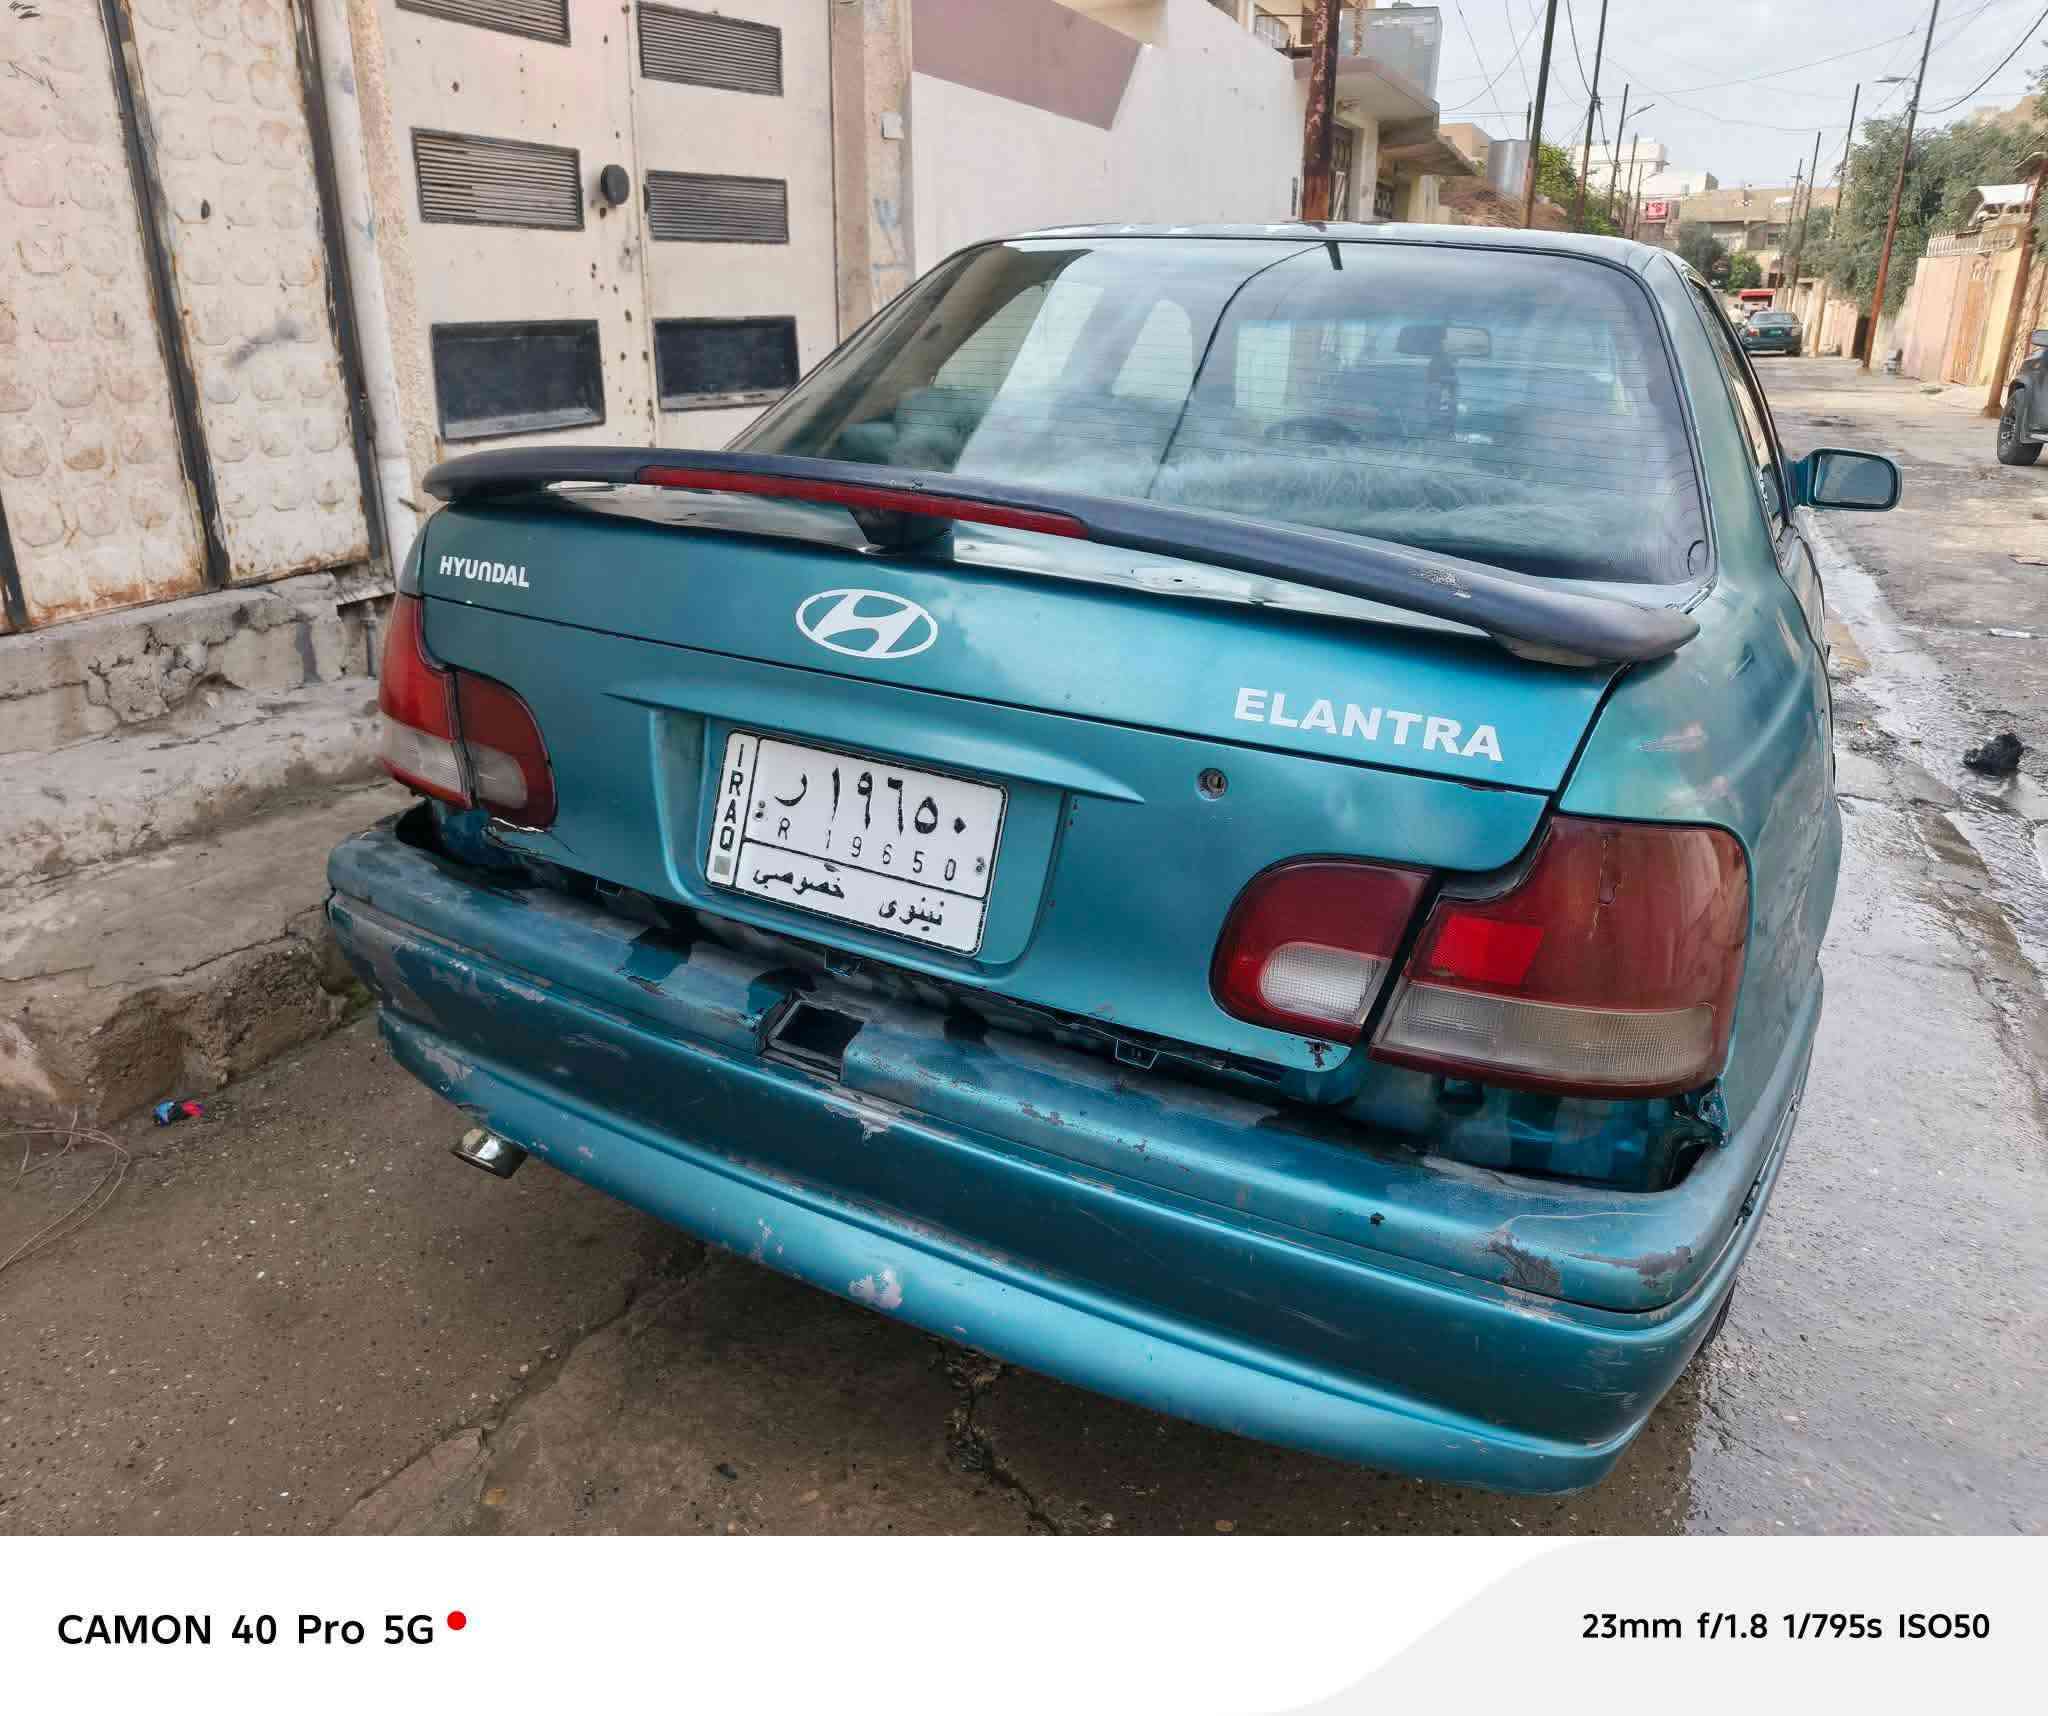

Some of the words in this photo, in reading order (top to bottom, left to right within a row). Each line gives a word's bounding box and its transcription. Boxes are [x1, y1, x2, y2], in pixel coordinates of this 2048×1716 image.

[1234, 687, 1504, 762] ELANTRA
[719, 743, 745, 852] IRAQ
[777, 817, 792, 841] R
[825, 829, 957, 882] 19650
